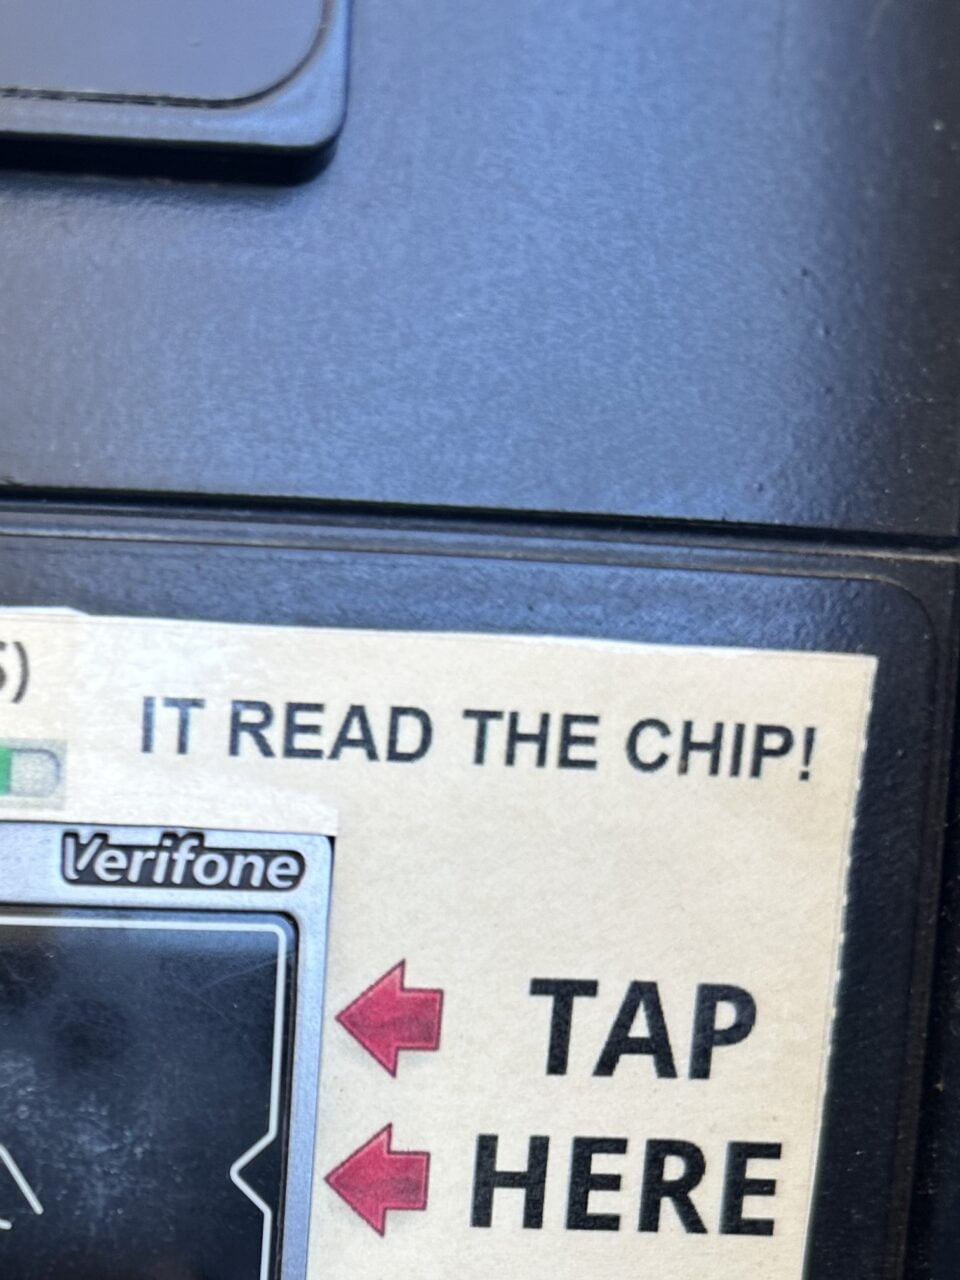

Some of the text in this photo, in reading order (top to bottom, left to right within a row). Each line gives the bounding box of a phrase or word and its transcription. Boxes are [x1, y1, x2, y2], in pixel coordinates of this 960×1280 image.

[140, 696, 817, 782] IT READ THE CHIP!
[62, 831, 303, 890] Verifone
[529, 978, 757, 1080] TAP
[470, 1134, 782, 1236] HERE
